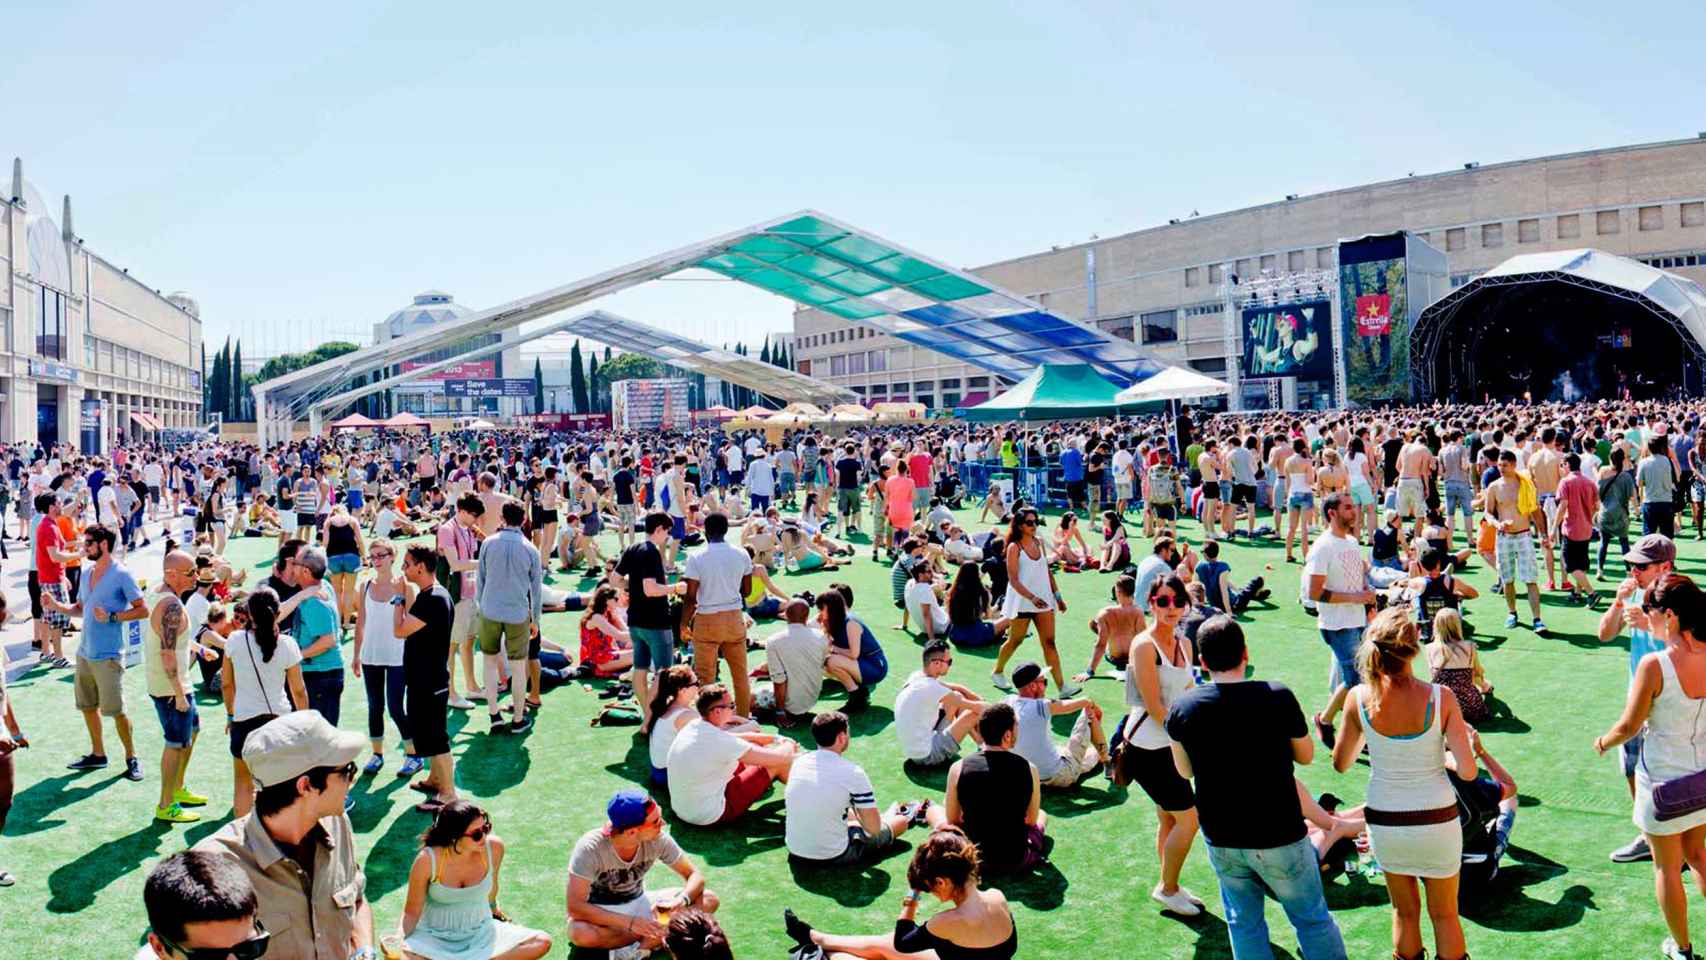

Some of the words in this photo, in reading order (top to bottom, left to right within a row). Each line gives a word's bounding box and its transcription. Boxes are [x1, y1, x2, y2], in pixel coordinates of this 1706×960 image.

[1360, 315, 1388, 326] Estrella
[466, 380, 486, 389] Save
[466, 388, 480, 396] the
[480, 388, 503, 396] dates
